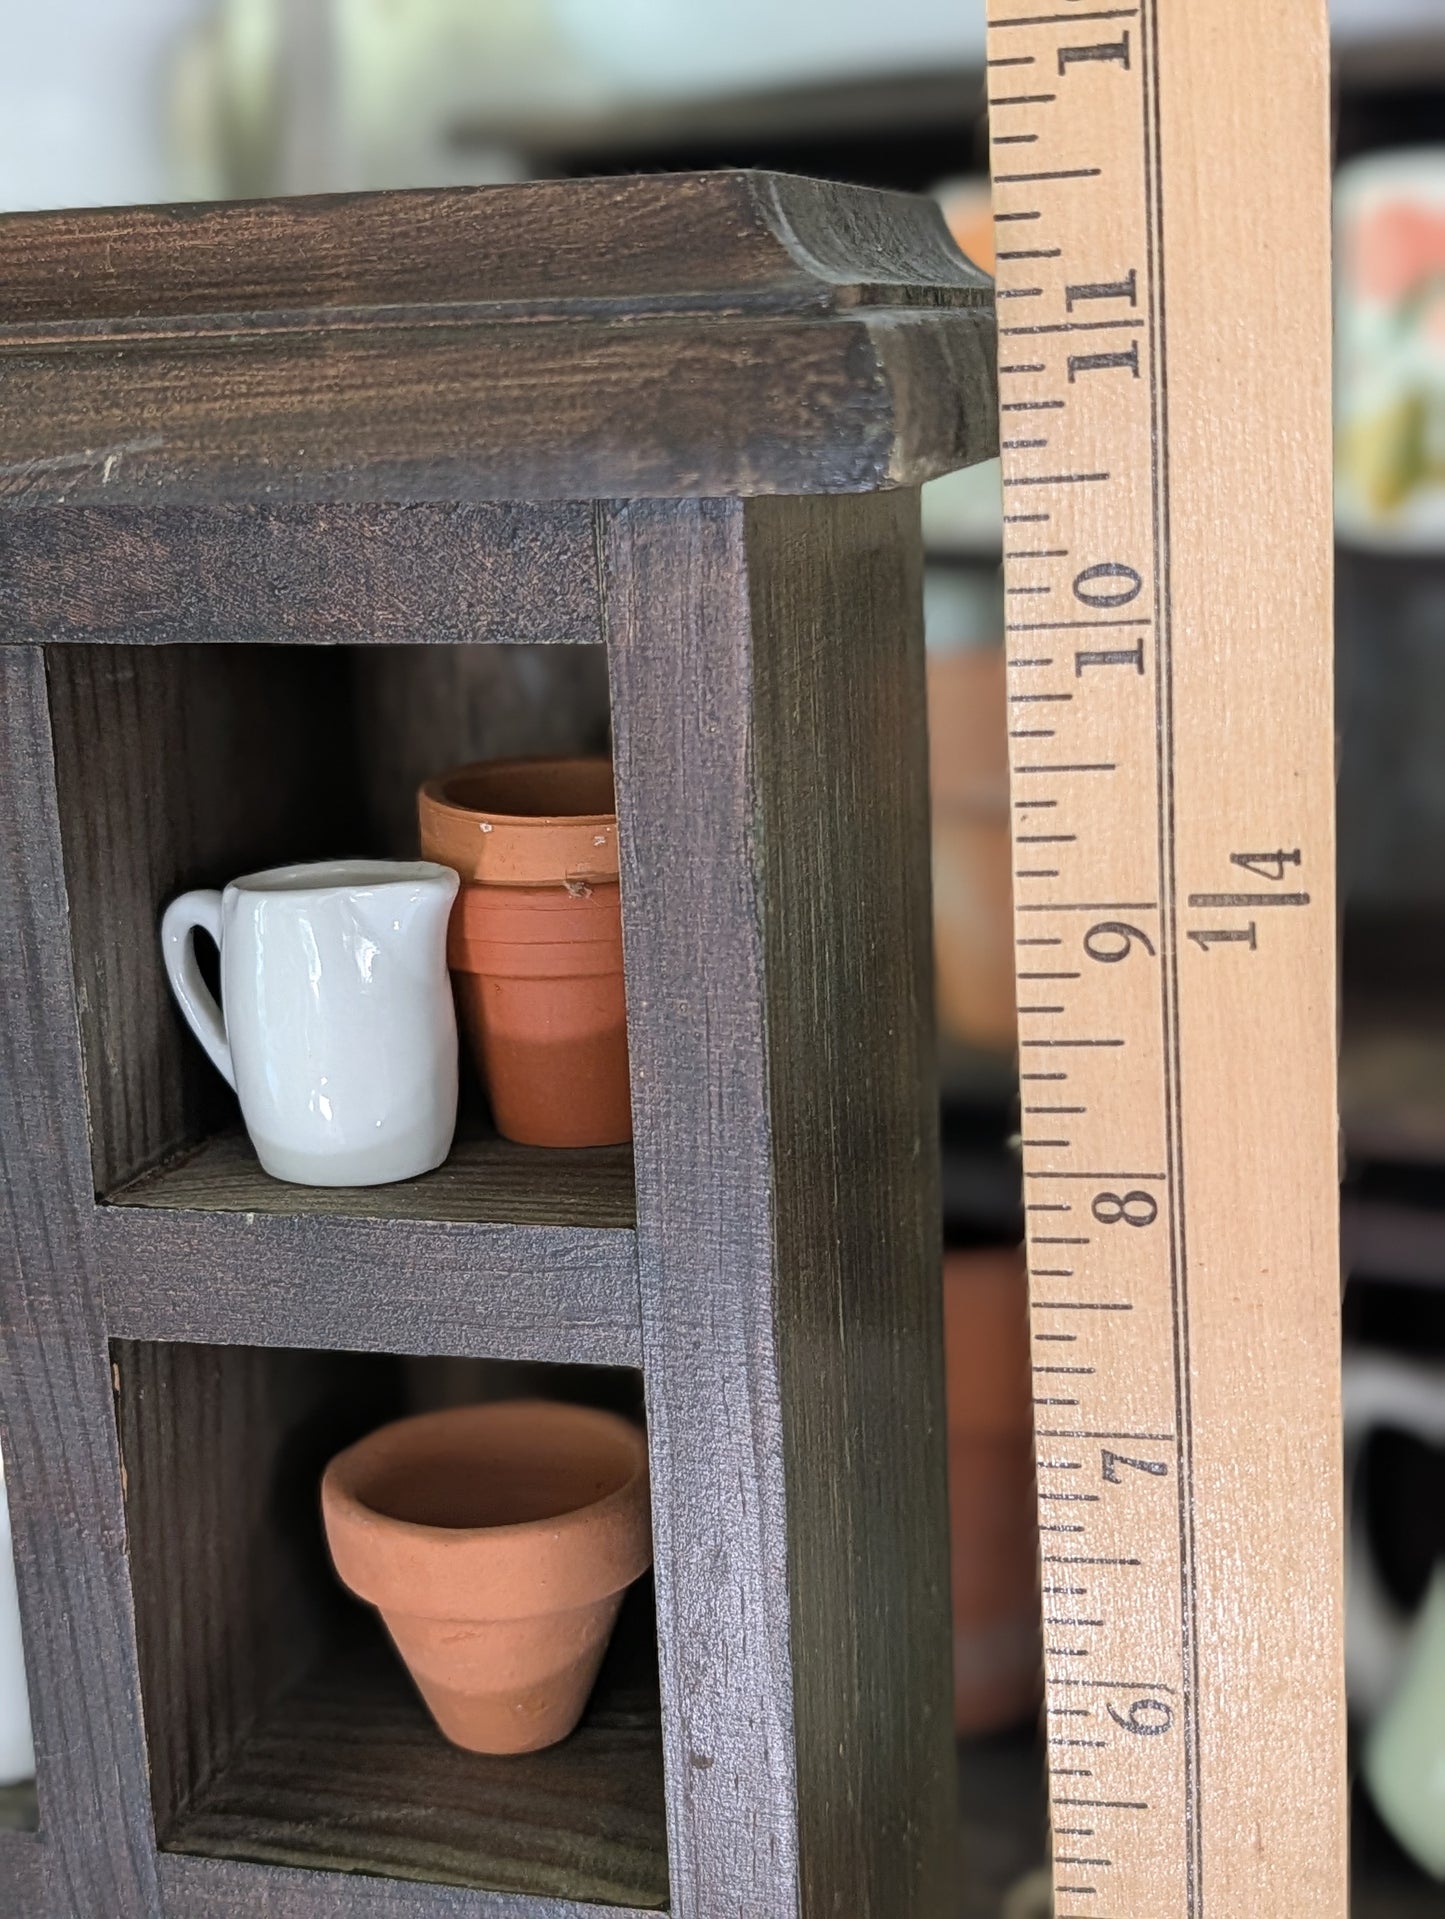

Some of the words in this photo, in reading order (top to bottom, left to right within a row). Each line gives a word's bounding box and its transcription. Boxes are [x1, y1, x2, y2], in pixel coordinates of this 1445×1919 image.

[1065, 269, 1140, 383] 11
[1073, 563, 1145, 678] 10
[1083, 921, 1156, 963] 9
[1091, 1191, 1158, 1227] 8
[1101, 1449, 1168, 1484] 7
[1106, 1699, 1175, 1736] 6
